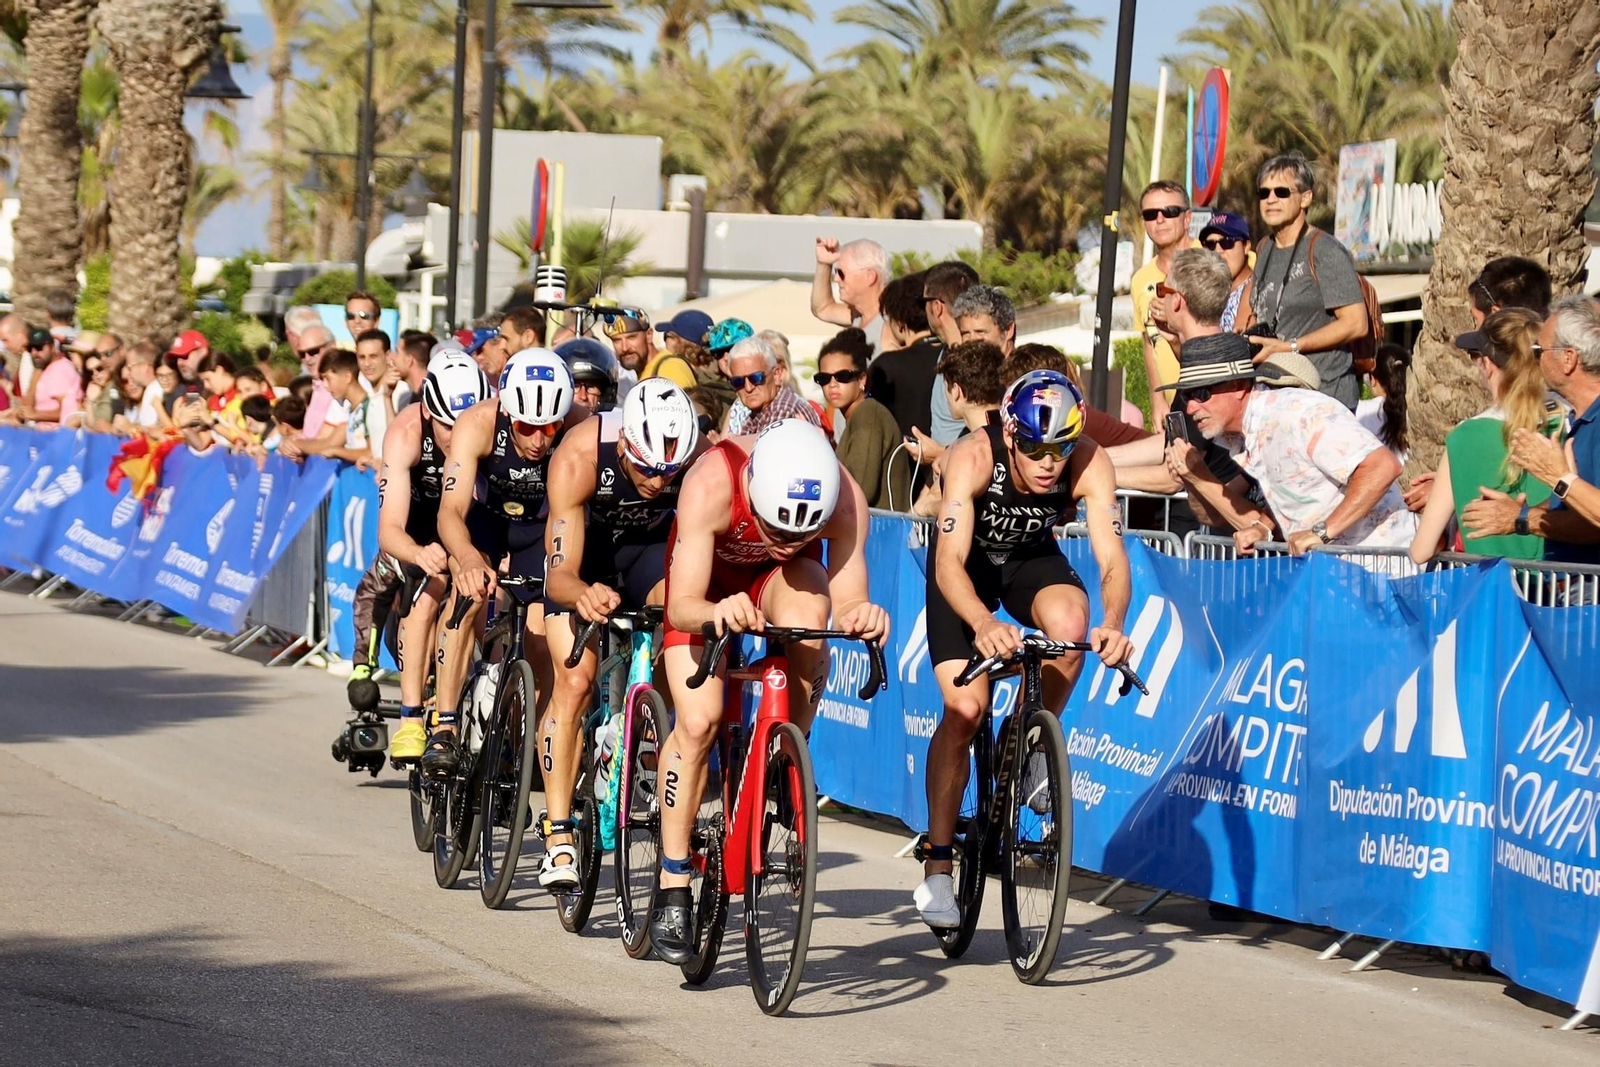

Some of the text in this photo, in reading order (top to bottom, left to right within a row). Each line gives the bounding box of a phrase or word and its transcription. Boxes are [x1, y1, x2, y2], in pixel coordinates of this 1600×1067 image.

[532, 368, 539, 376] 2
[454, 398, 464, 406] 20
[1032, 397, 1062, 408] Red Bull
[656, 463, 667, 471] 10
[444, 476, 457, 492] 2
[794, 483, 805, 493] 26
[990, 501, 1057, 517] CANYON
[942, 517, 957, 533] 3
[981, 510, 1058, 533] WILDE
[1112, 520, 1123, 537] 3
[988, 528, 1032, 543] NZL
[549, 536, 566, 570] 10
[437, 648, 446, 665] 2
[826, 645, 872, 703] OMPIT
[809, 674, 824, 704] 26
[904, 708, 937, 738] rovincial
[543, 735, 553, 773] 10
[1093, 733, 1164, 777] Provincial
[664, 769, 679, 809] 26
[1233, 783, 1259, 810] EN
[1329, 779, 1403, 822] Diputación
[1359, 831, 1451, 880] de Málaga
[1504, 840, 1552, 886] PROVINCIA
[1552, 861, 1569, 892] EN
